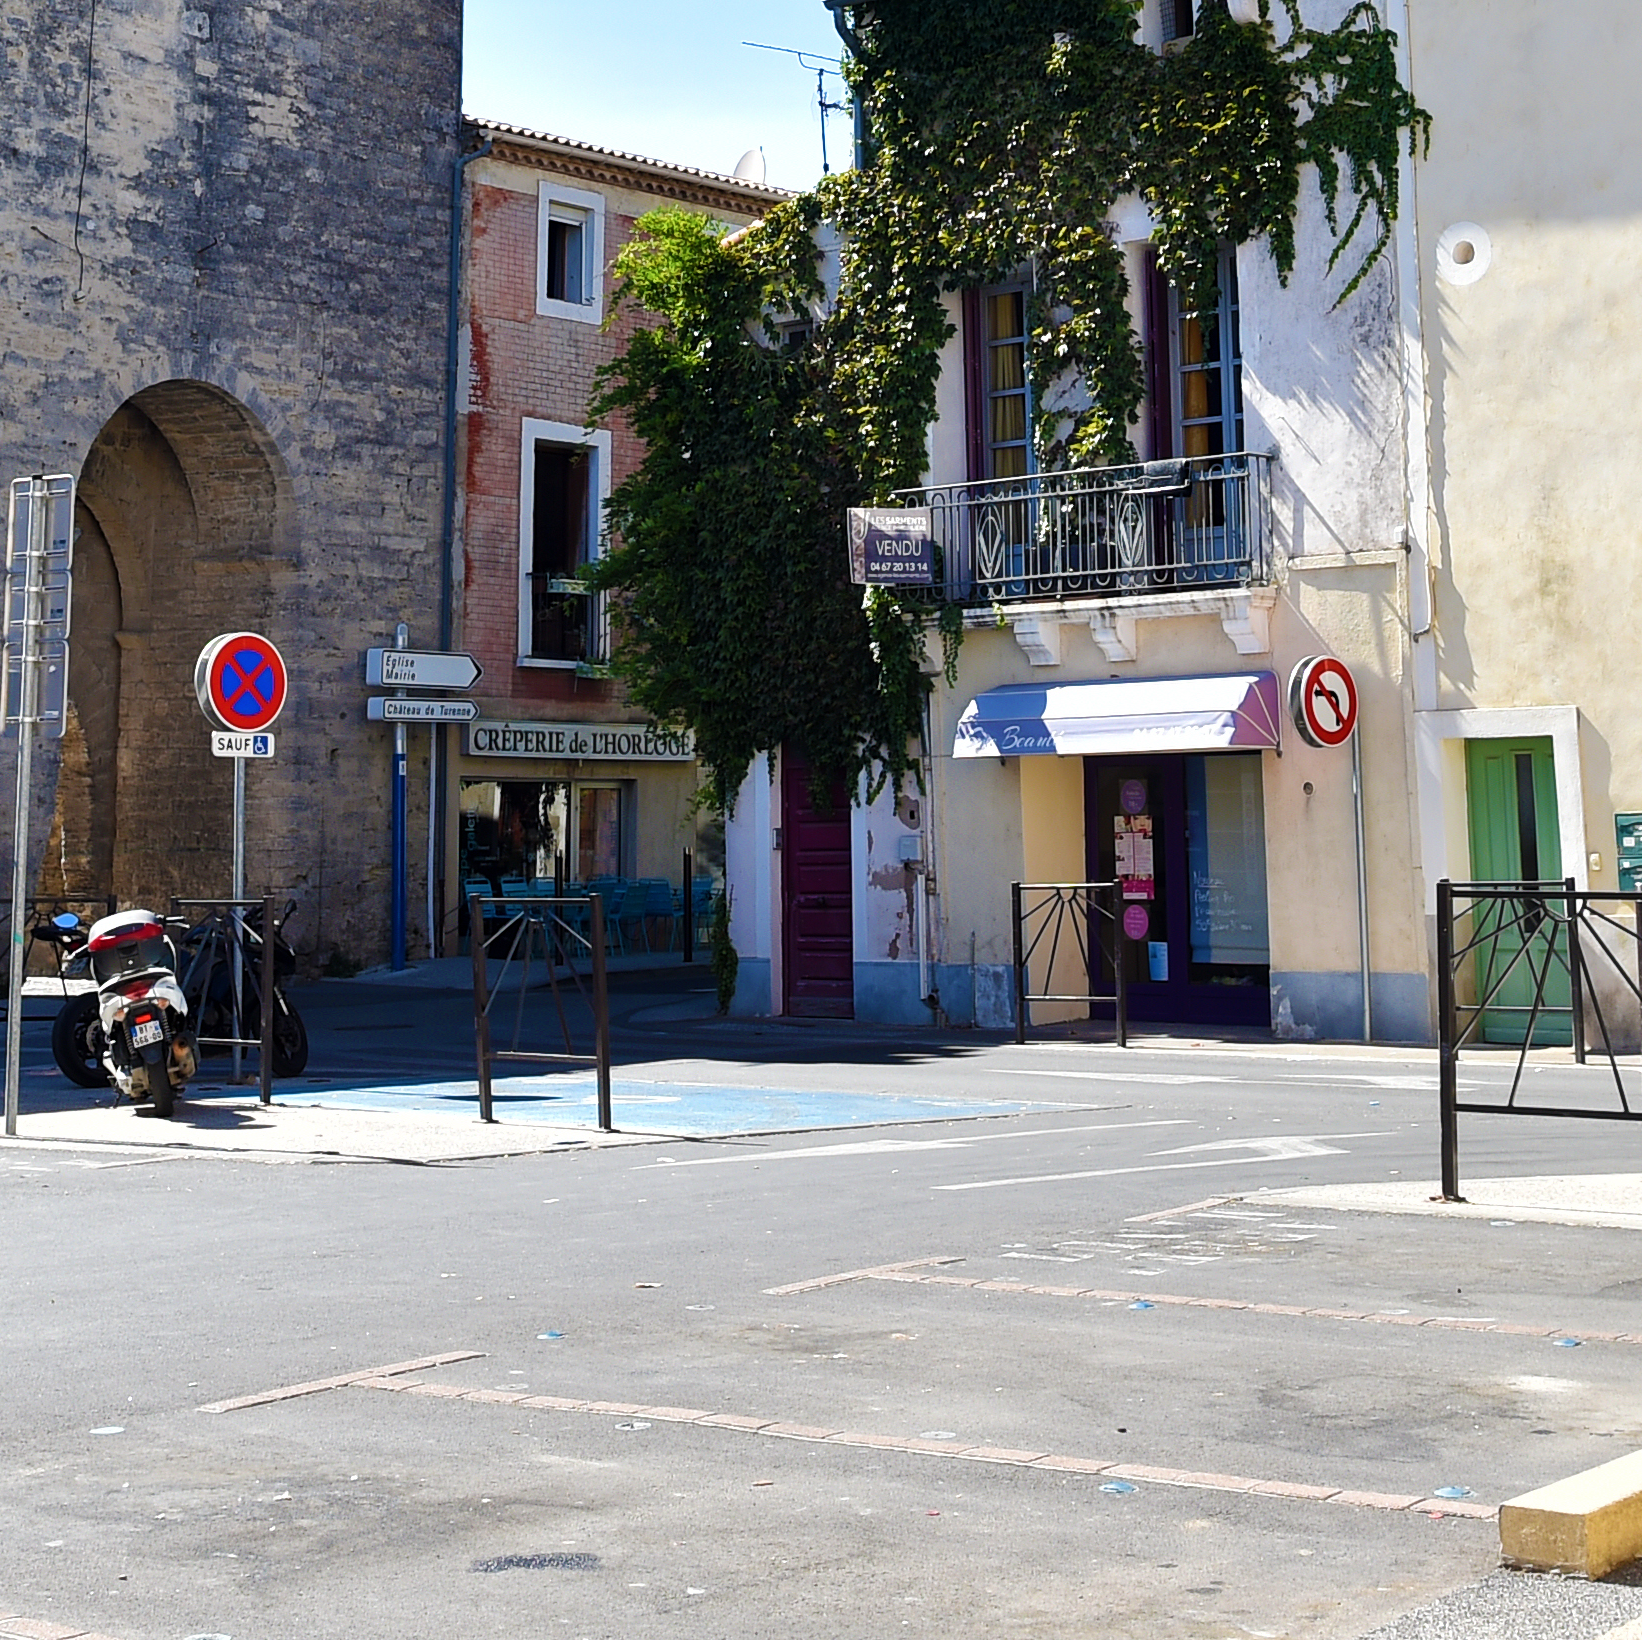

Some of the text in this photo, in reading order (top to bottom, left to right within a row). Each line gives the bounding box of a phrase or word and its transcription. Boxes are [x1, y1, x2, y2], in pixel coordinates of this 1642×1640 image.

[876, 540, 922, 557] VENDU
[870, 562, 880, 572] 04
[881, 562, 892, 571] 67
[905, 562, 916, 571] 13
[917, 562, 928, 571] 14
[385, 654, 415, 670] Église
[385, 669, 416, 681] Mairie
[387, 703, 471, 716] Château de Turenne
[217, 737, 251, 752] SAUF
[473, 723, 566, 753] CRÊPERIE
[569, 730, 588, 754] de
